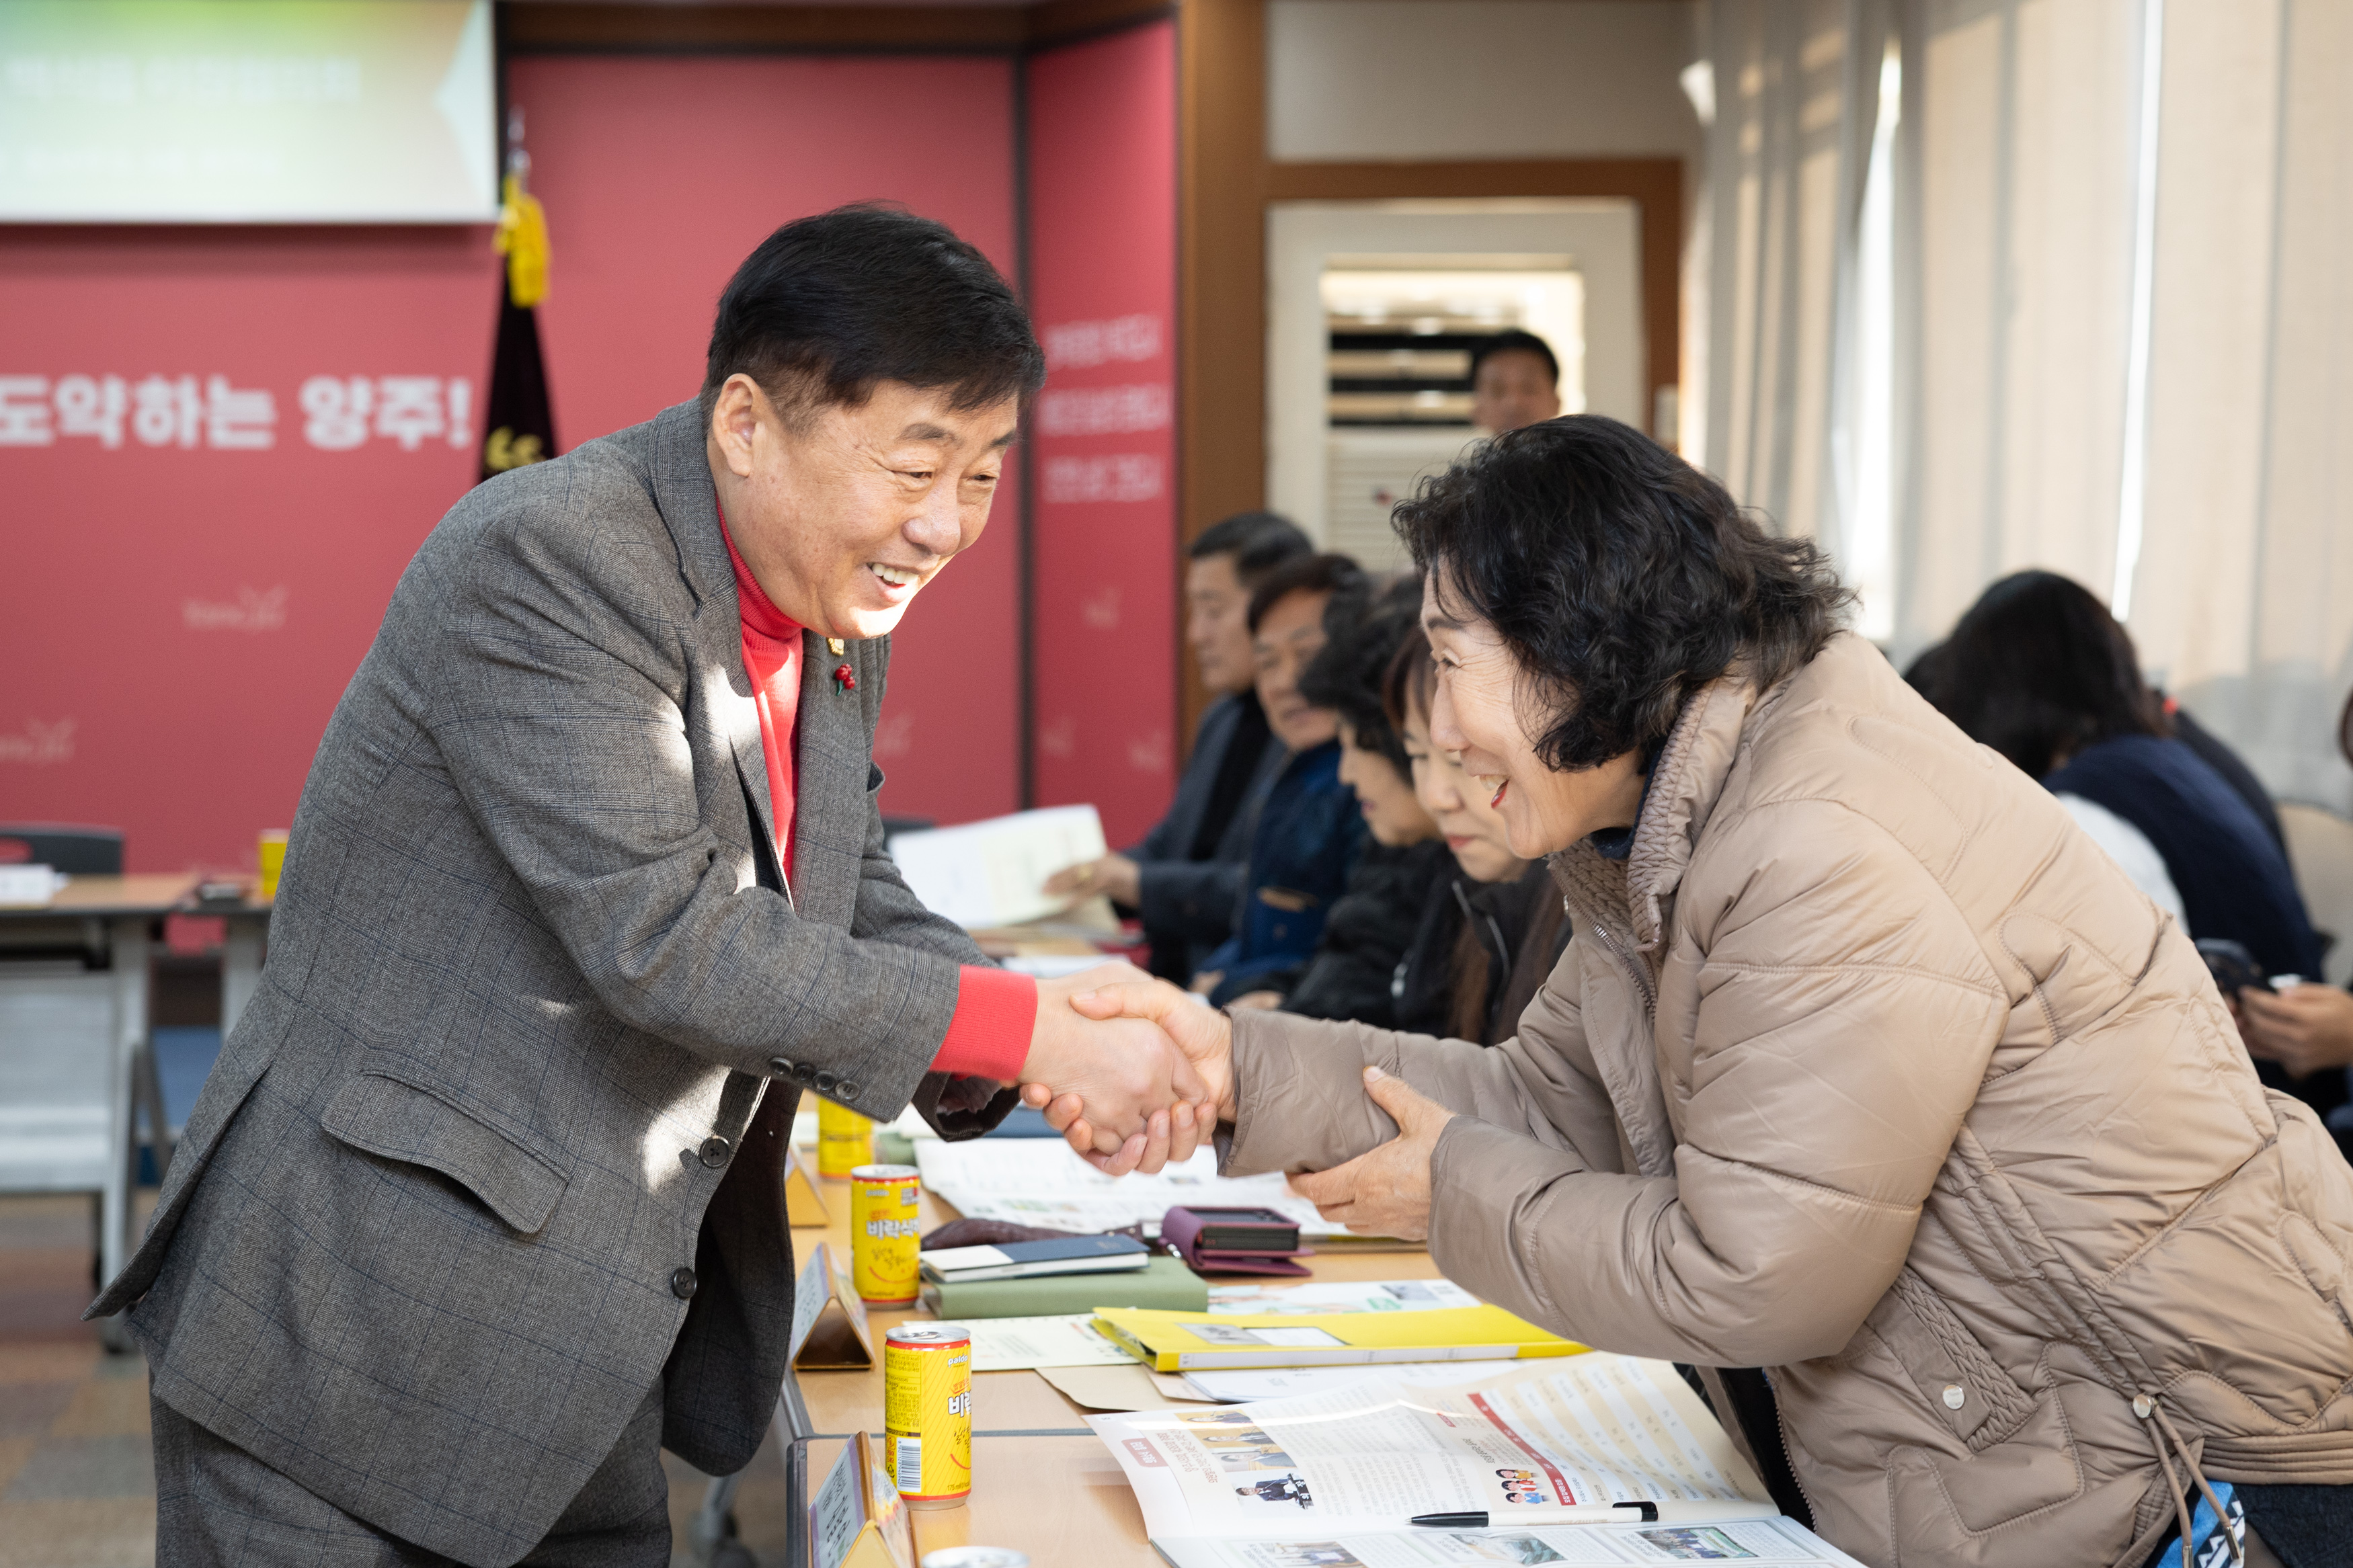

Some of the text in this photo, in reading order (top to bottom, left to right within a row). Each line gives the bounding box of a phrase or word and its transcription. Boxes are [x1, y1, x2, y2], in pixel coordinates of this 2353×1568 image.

[0, 373, 473, 450] 도약하는 양주!
[948, 1354, 968, 1368] paldo
